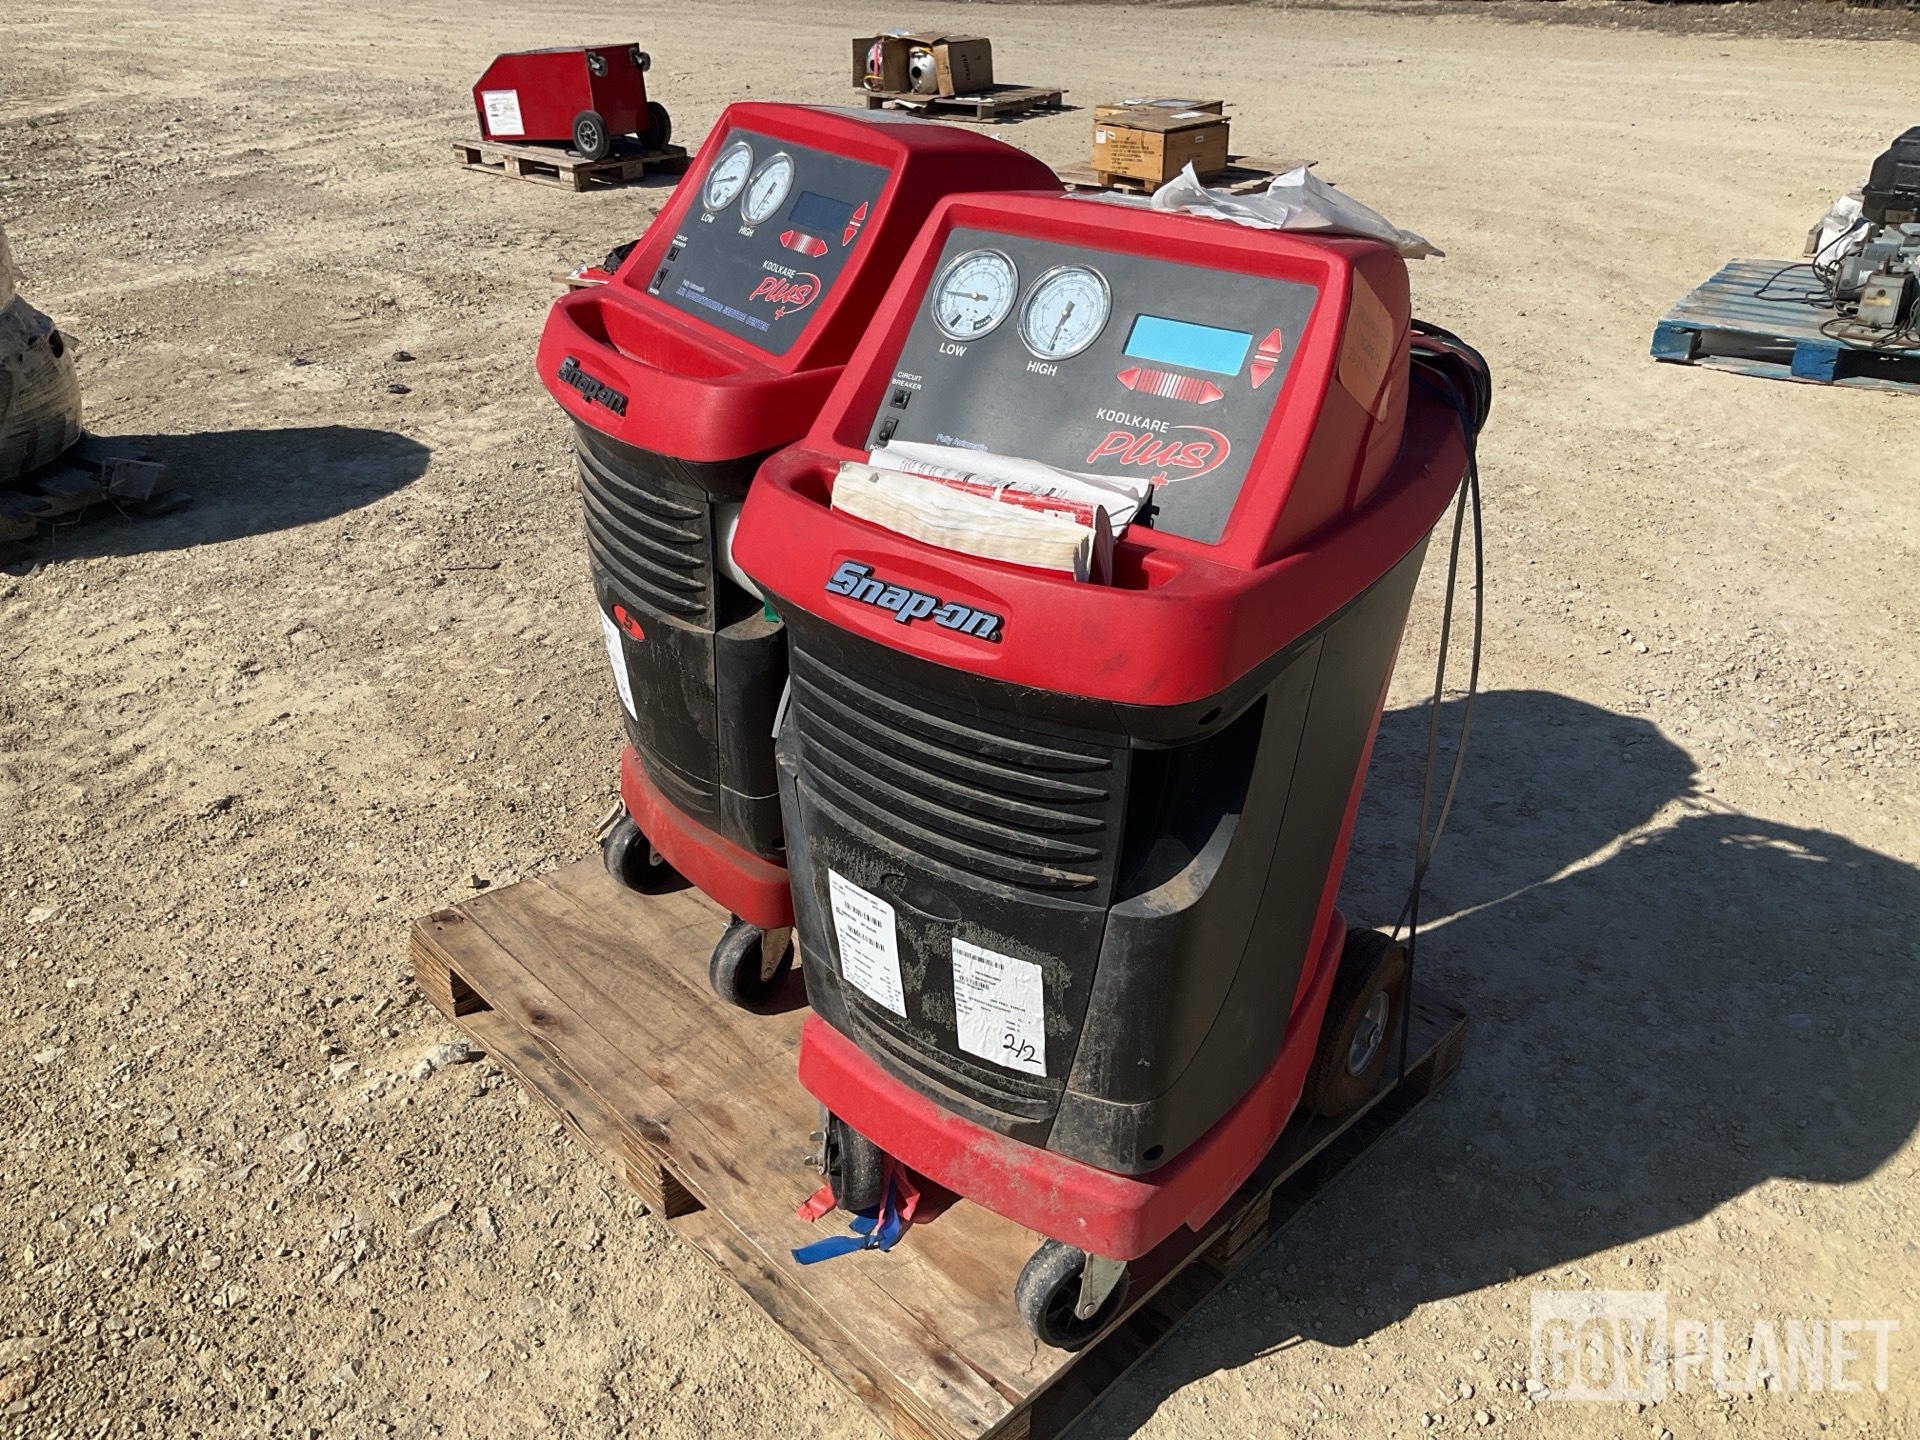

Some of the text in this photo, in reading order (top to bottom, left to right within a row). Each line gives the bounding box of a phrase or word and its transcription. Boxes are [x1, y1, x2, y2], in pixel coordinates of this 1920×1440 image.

[701, 212, 715, 223] LOW
[738, 225, 754, 237] HIGH
[763, 260, 796, 278] KOOLKARE
[939, 342, 967, 357] LOW
[897, 371, 922, 382] CIRCUIT
[1026, 361, 1058, 377] HIGH
[891, 378, 922, 390] BREAKER
[1096, 408, 1170, 434] KOOLKARE
[936, 433, 988, 452] Fully Automatic
[824, 560, 1002, 641] Snap-on
[1003, 1033, 1042, 1065] 2/2
